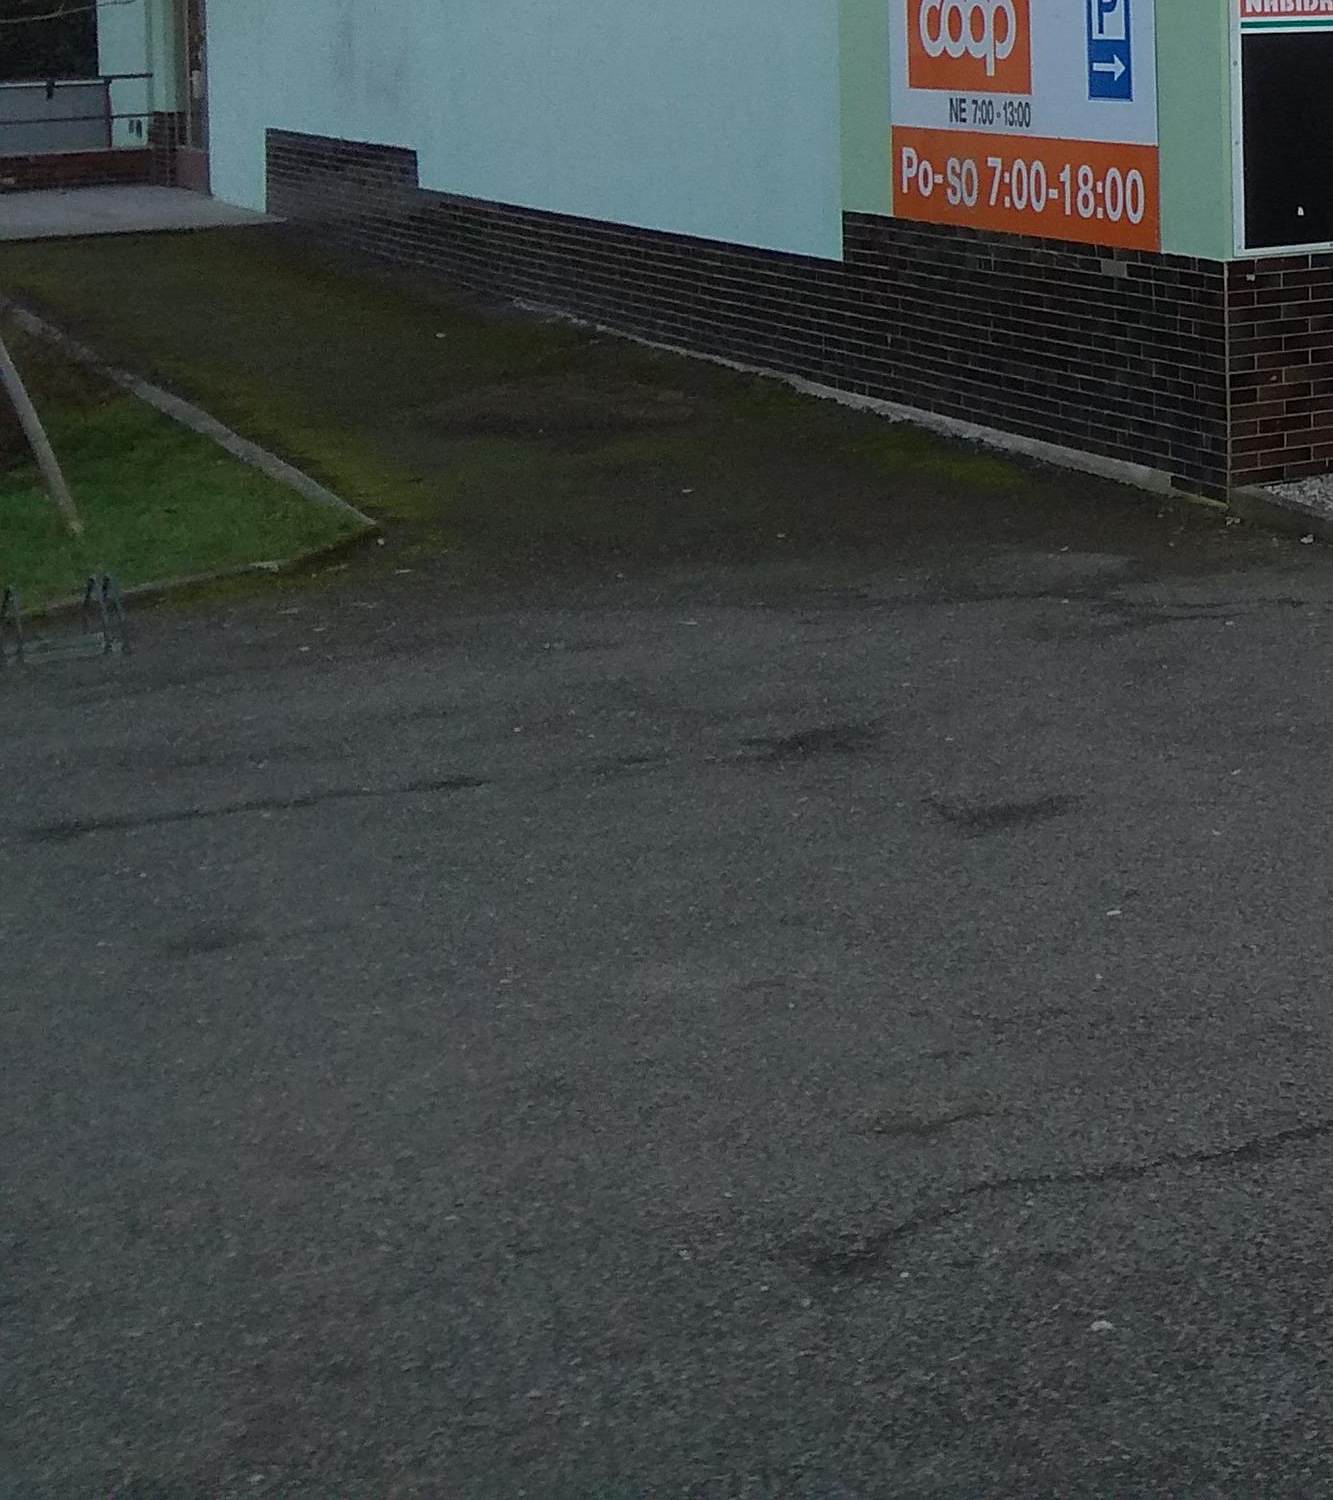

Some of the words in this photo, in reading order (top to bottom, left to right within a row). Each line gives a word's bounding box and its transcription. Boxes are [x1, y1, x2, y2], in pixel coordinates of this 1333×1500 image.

[949, 98, 968, 124] NE
[972, 99, 994, 126] 7:00
[1003, 101, 1032, 128] 13:00
